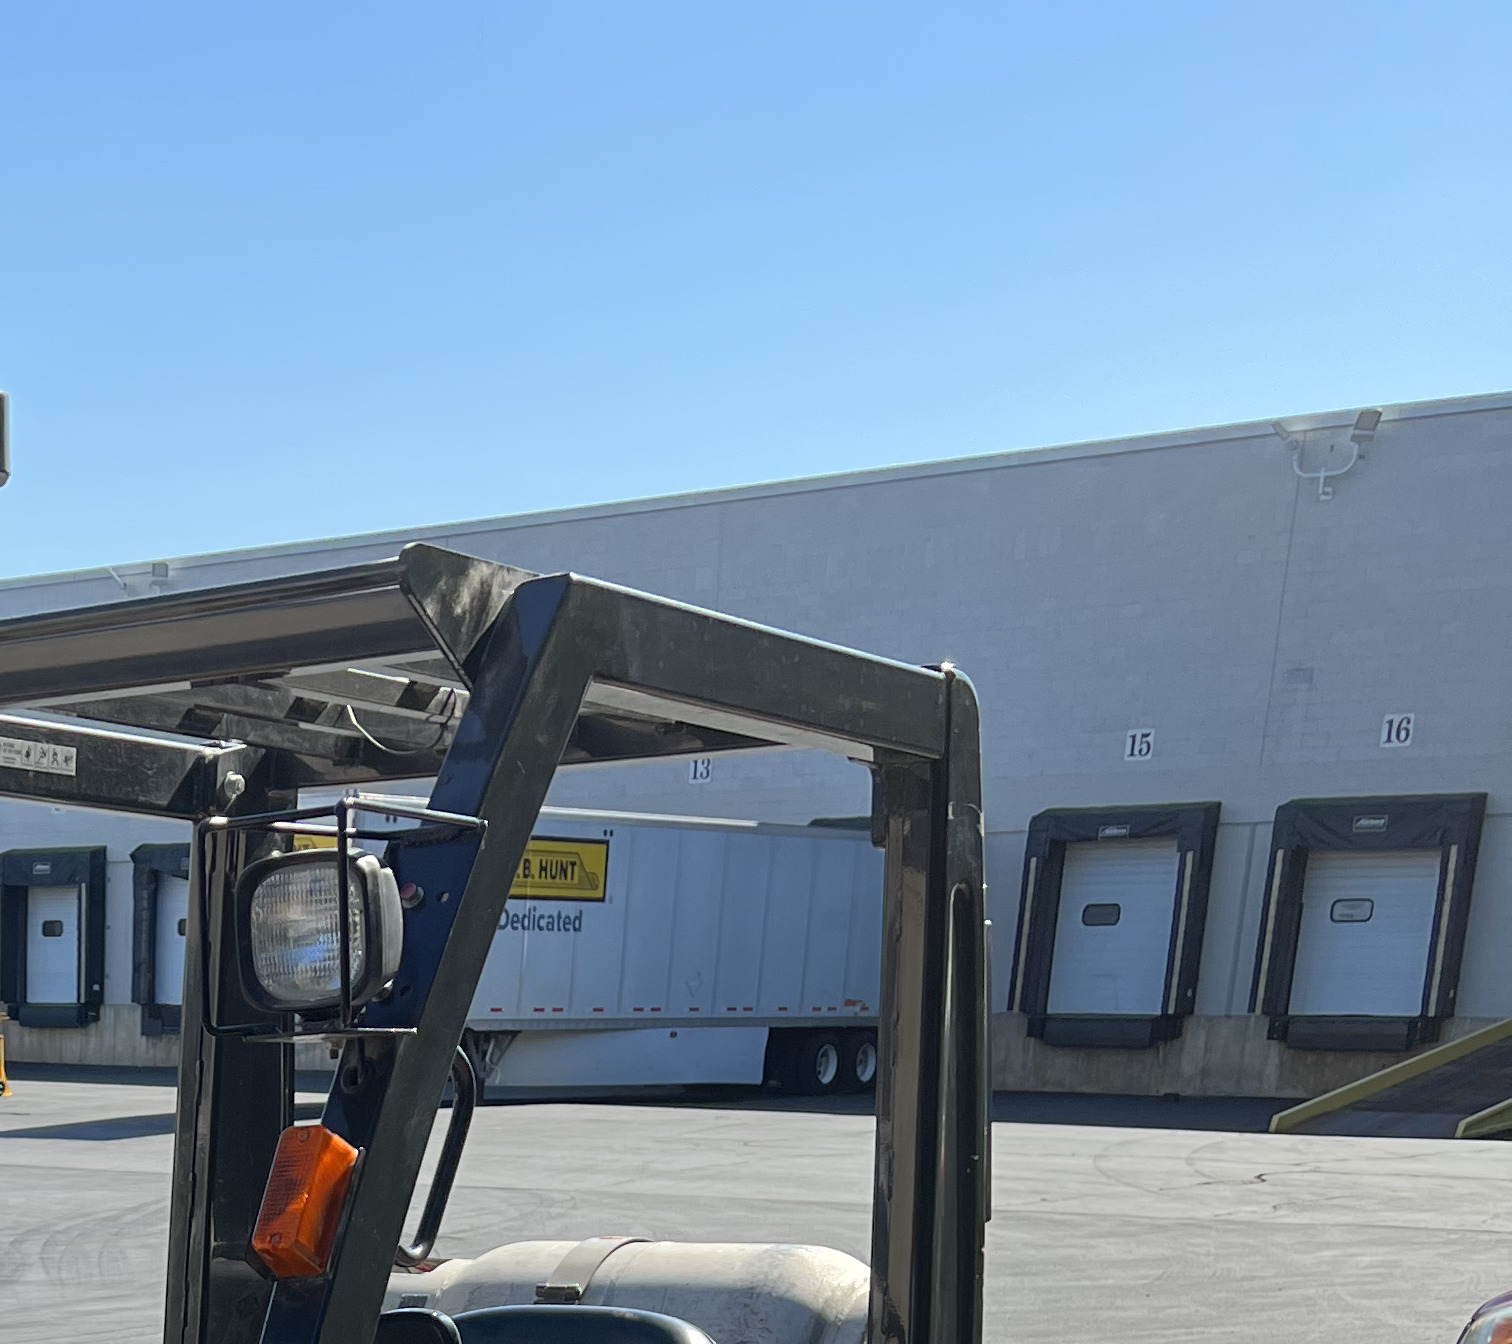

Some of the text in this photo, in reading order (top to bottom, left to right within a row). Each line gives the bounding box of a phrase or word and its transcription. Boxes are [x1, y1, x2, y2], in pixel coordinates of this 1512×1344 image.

[1384, 717, 1411, 744] 16
[1126, 732, 1151, 758] 15
[691, 757, 711, 780] 13
[517, 858, 576, 881] .B. HUNT
